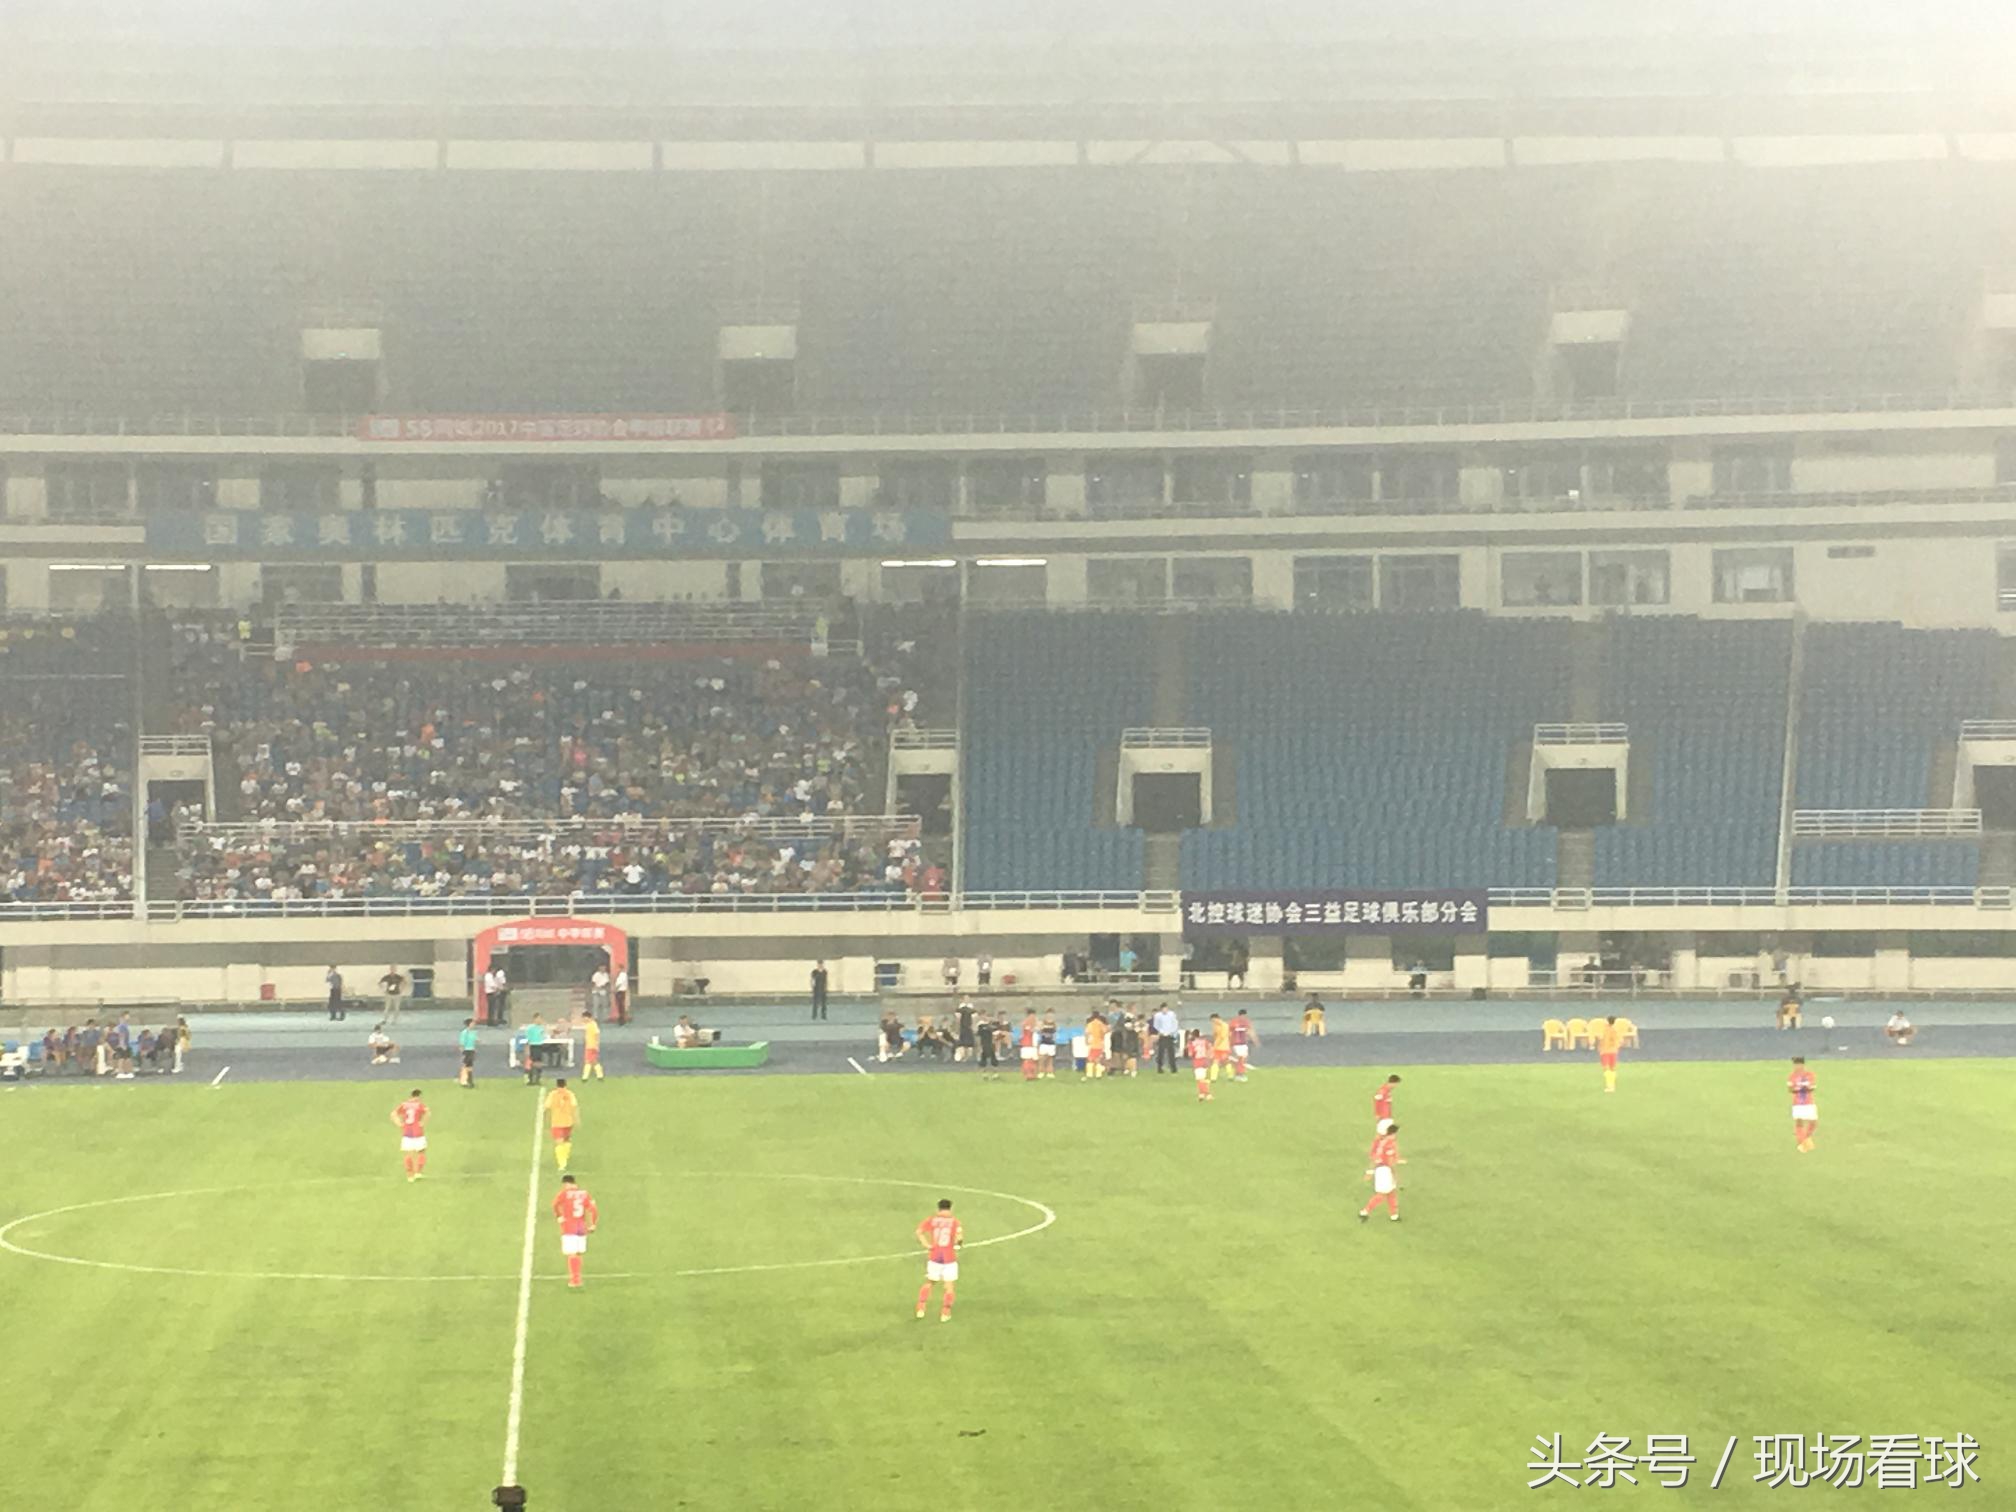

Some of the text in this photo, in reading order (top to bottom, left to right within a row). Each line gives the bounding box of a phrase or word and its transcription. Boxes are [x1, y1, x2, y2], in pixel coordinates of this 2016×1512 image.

[203, 510, 907, 545] 国家奥林匹克体育中心体育场
[1188, 901, 1478, 924] 北控球迷协会三益足球俱乐部分会
[572, 1199, 585, 1218] 5
